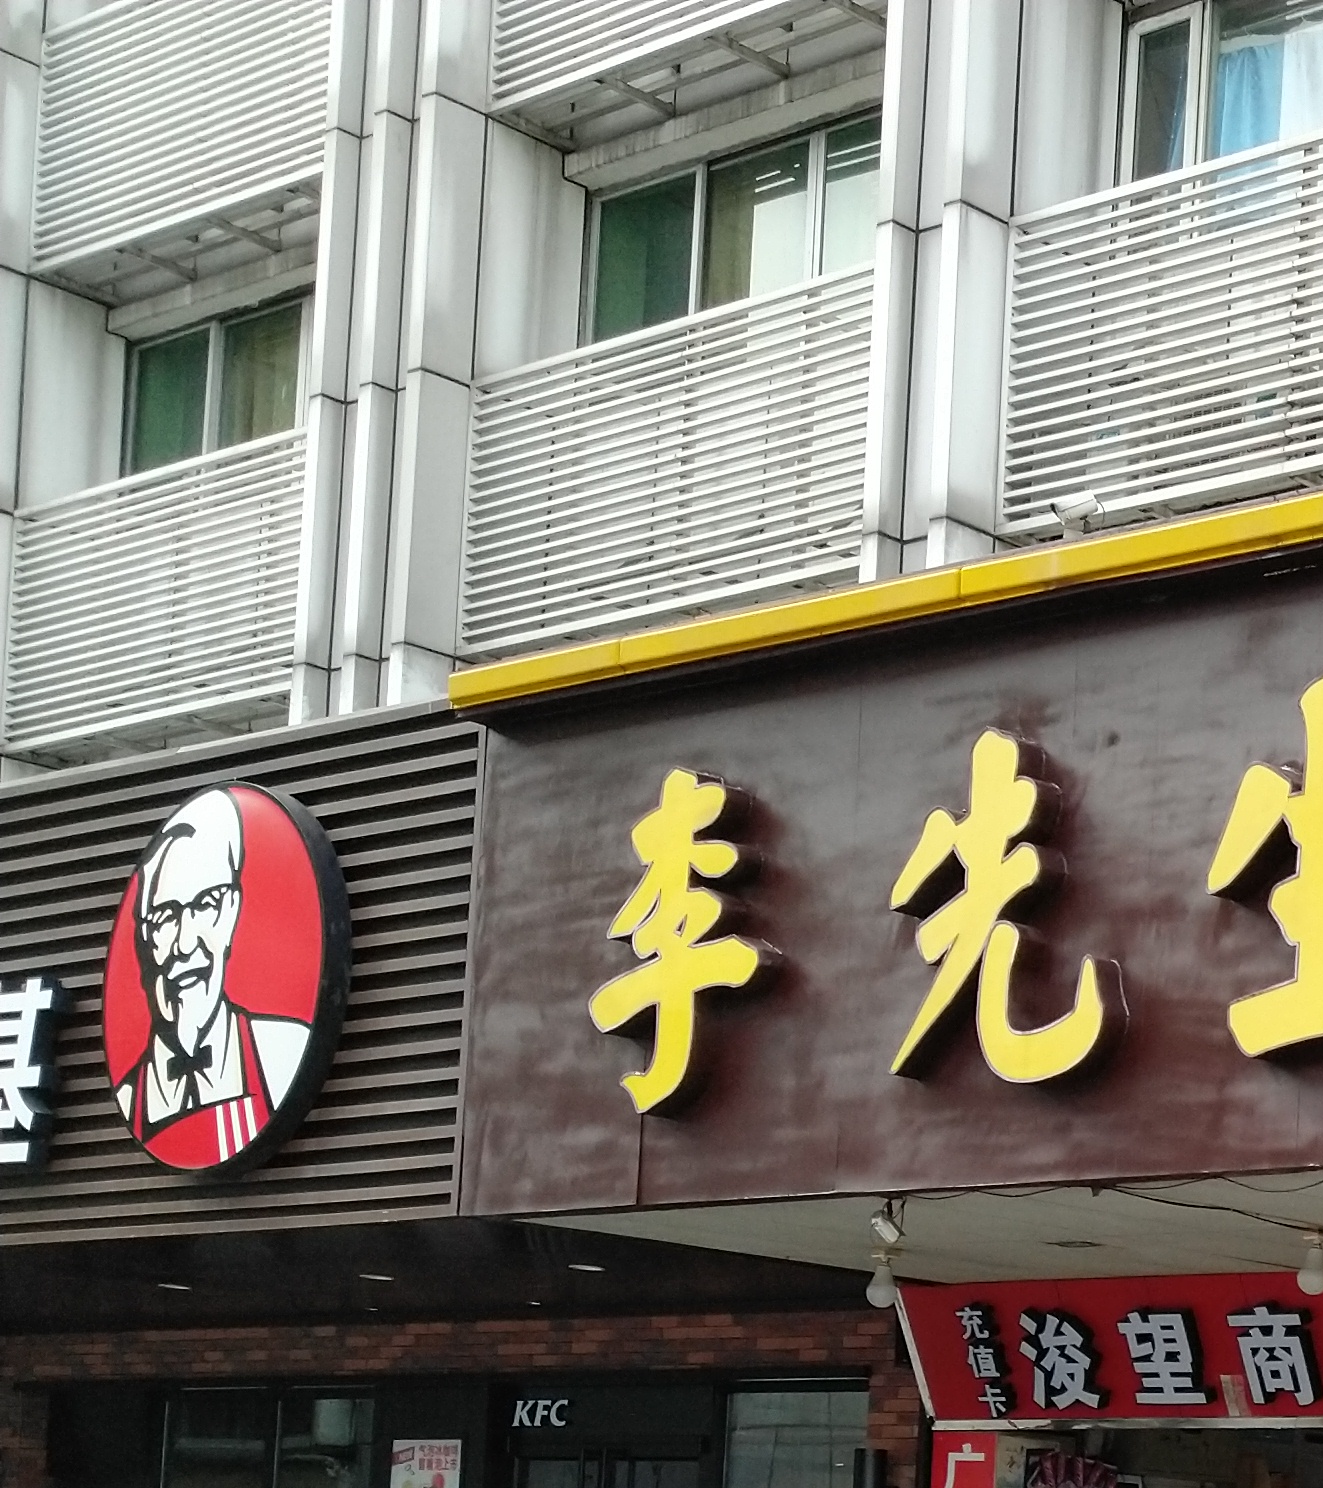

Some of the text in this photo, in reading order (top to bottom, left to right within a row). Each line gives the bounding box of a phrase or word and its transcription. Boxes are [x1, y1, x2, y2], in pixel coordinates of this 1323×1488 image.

[955, 1305, 1007, 1419] 充值卡
[512, 1398, 568, 1428] KFC
